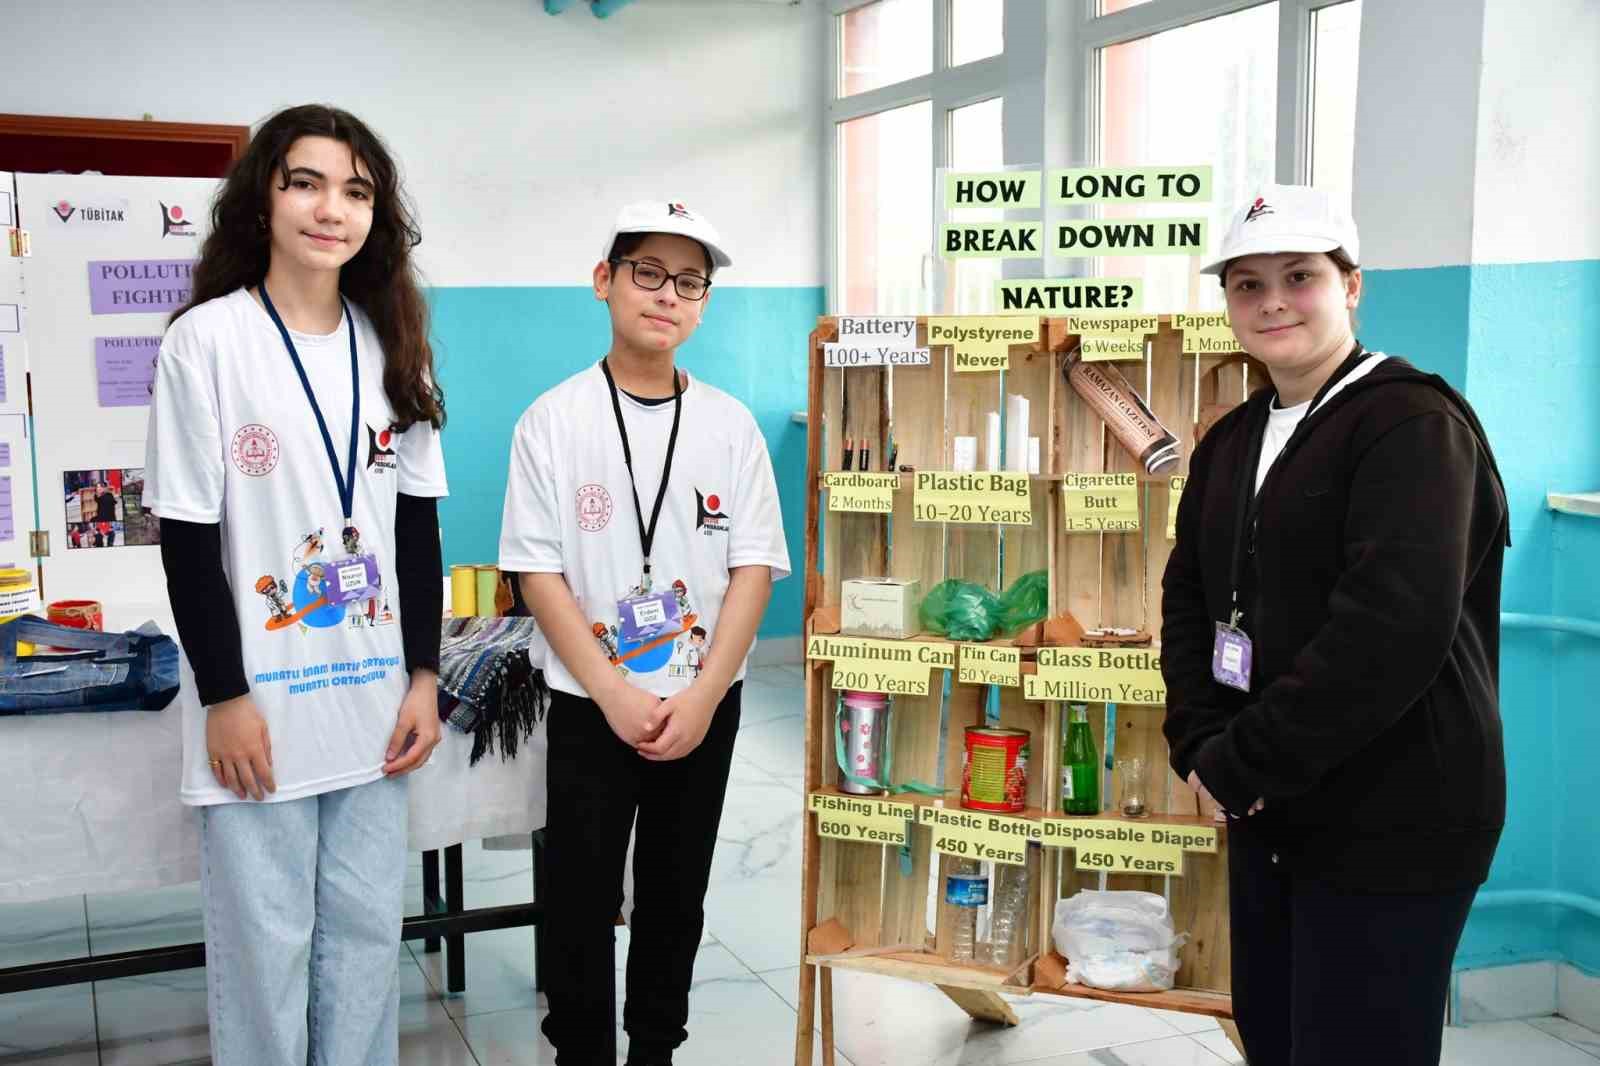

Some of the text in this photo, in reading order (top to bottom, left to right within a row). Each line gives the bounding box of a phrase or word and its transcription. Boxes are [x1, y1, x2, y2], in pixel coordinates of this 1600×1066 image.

[955, 173, 1201, 203] HOW LONG TO
[80, 207, 124, 222] TÜBİTAK
[945, 223, 1201, 252] BREAK DOWN IN
[102, 263, 193, 280] POLLUTI
[112, 288, 189, 305] FIGHTE
[1001, 285, 1134, 310] NATURE?
[841, 318, 915, 337] Battery
[931, 325, 1034, 342] Polystyrene
[1069, 317, 1157, 332] Newspaper
[103, 336, 162, 348] POLLUTIO
[1082, 340, 1144, 353] 6 Weeks
[1185, 337, 1242, 351] 1 Mont
[826, 347, 929, 365] 100+ Years
[956, 353, 1007, 366] Never
[1082, 366, 1120, 403] RAMAZAN
[824, 473, 899, 488] Cardboard
[917, 473, 1028, 496] Plastic Bag
[1063, 473, 1136, 490] Cigarette
[830, 495, 892, 511] 2 Months
[1084, 495, 1118, 509] Butt
[977, 505, 1032, 523] Years
[1097, 517, 1138, 530] Years
[808, 639, 955, 666] Aluminum Can
[962, 646, 1016, 663] Tin Can
[1037, 649, 1161, 671] Glass Bottle
[832, 672, 926, 694] 200 Years
[959, 668, 1018, 686] 50 Years
[1027, 680, 1166, 702] 1 Million Year
[812, 795, 914, 819] Fishing Line
[922, 808, 1042, 838] Plastic Bottle
[821, 821, 905, 844] 600 Years
[1043, 822, 1214, 850] Disposable Diaper
[935, 838, 1025, 864] 450 Years
[1080, 852, 1175, 872] 450 Years
